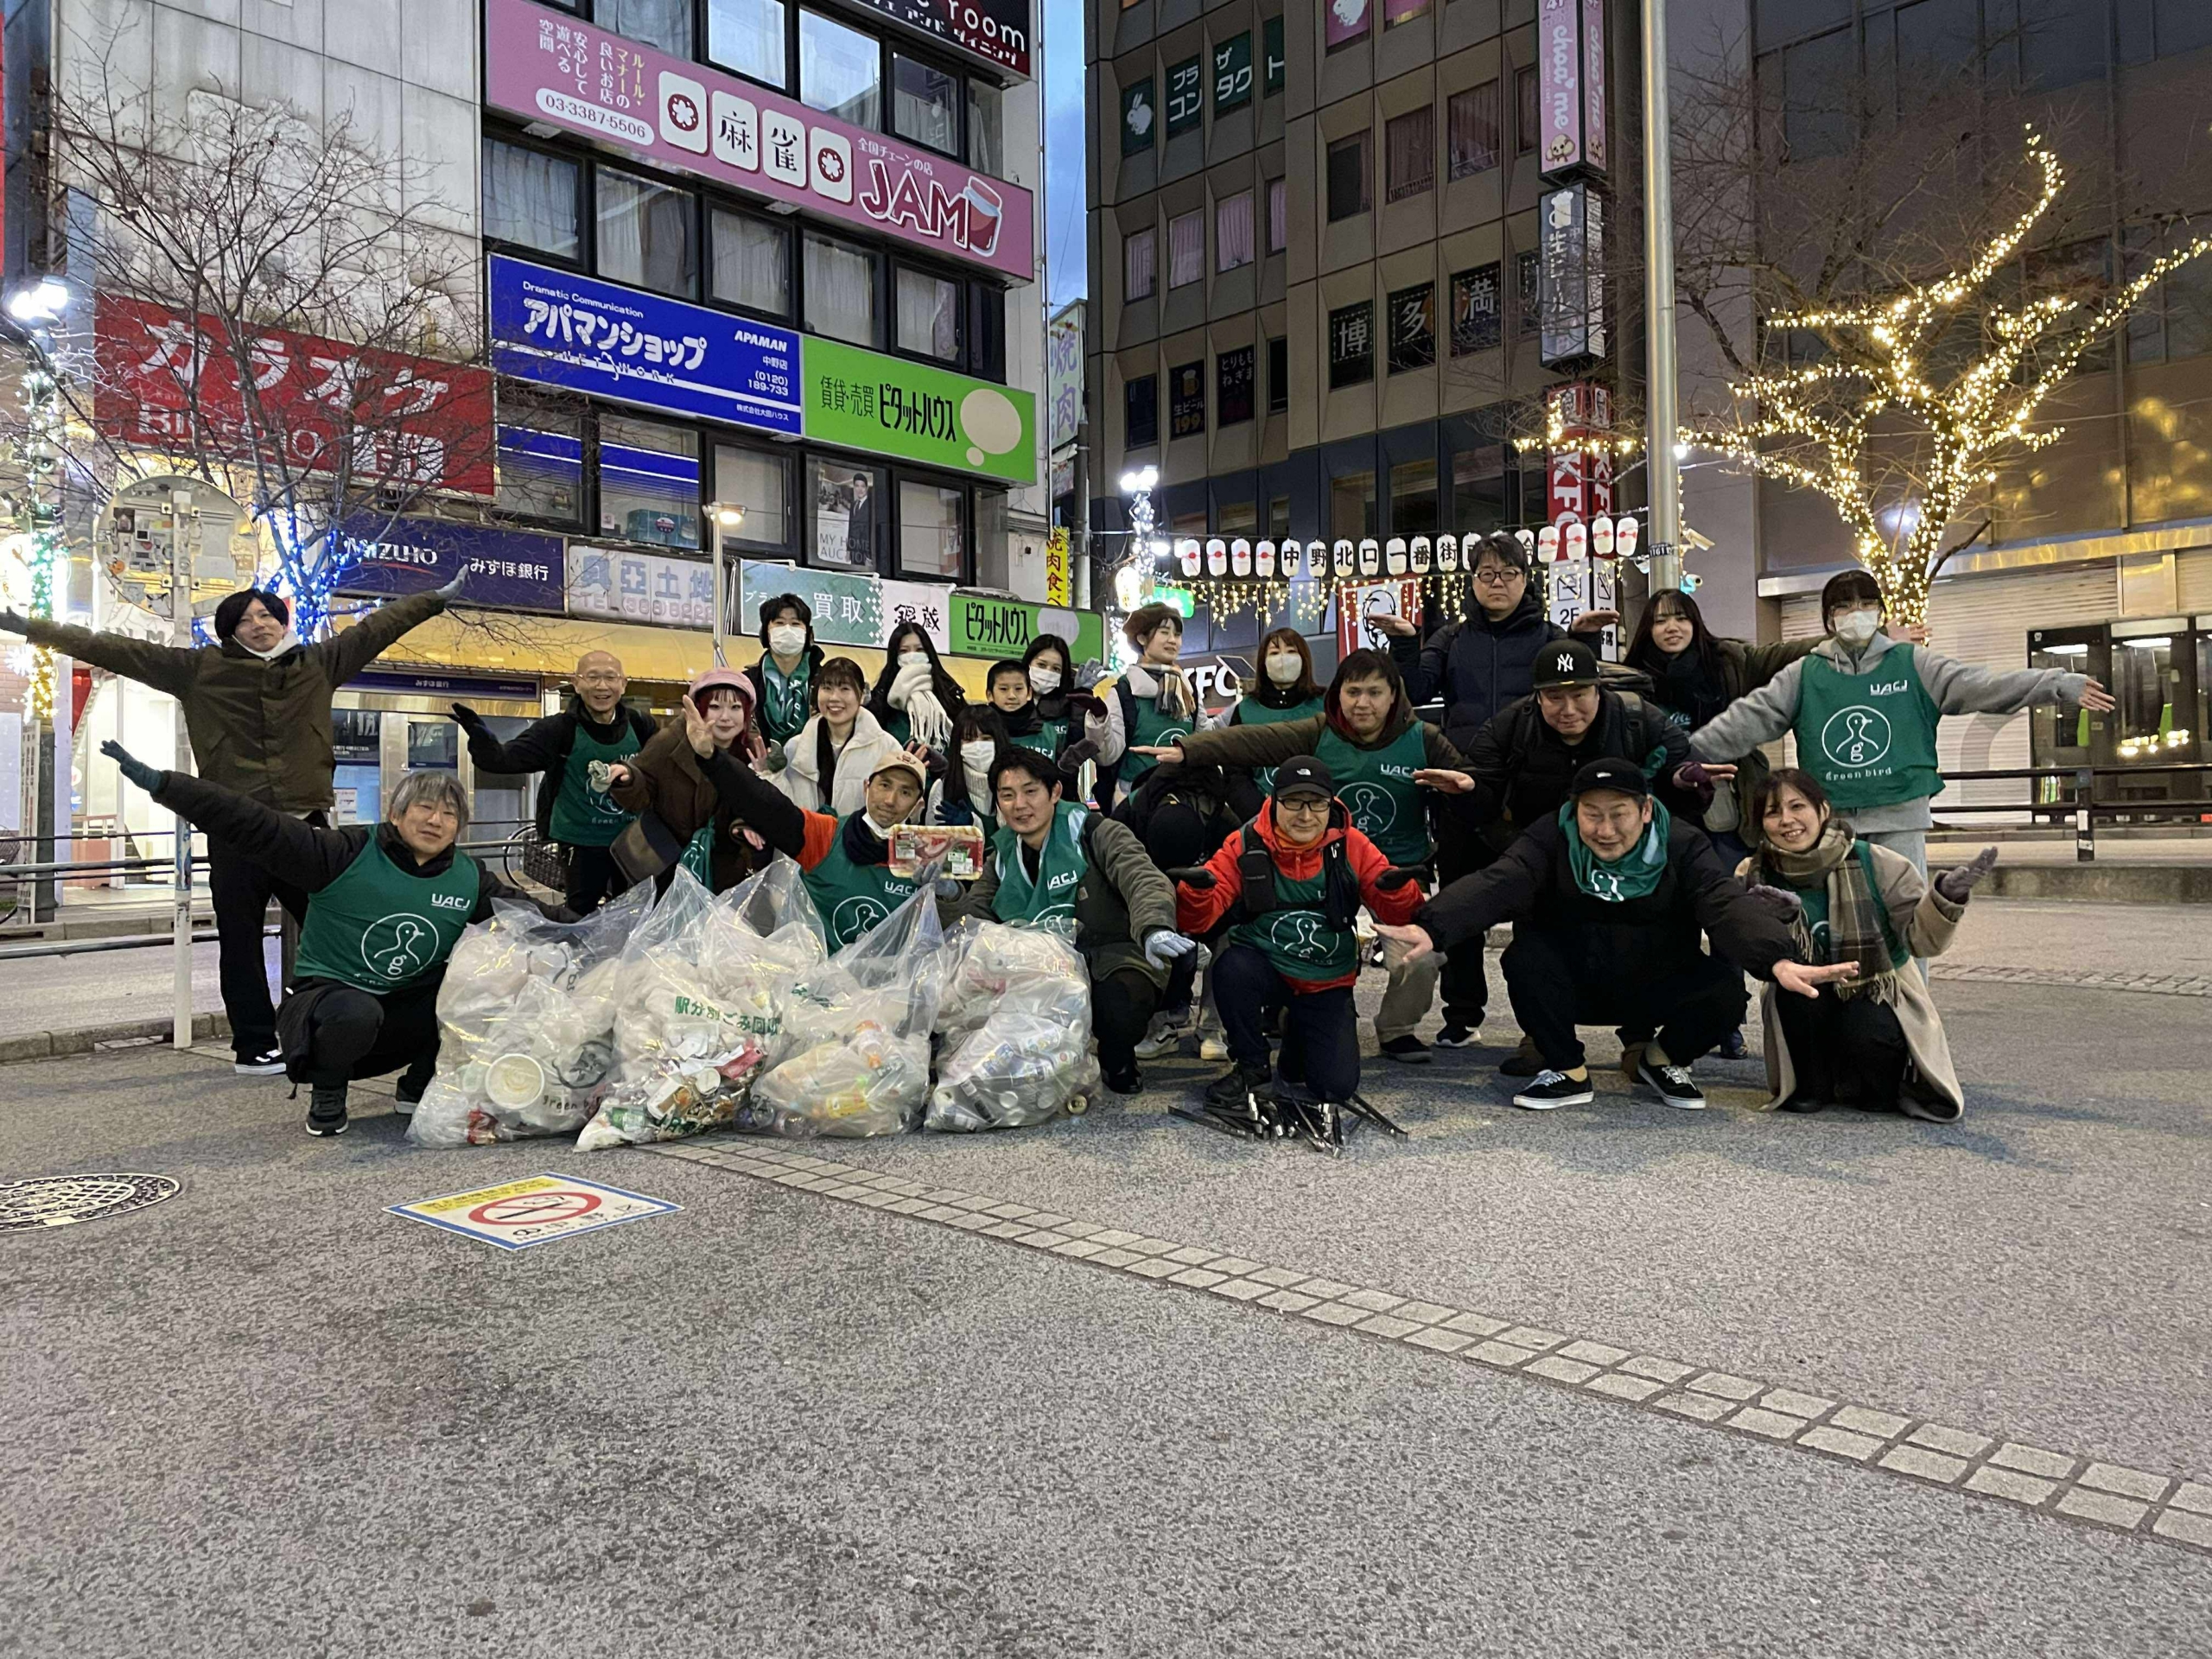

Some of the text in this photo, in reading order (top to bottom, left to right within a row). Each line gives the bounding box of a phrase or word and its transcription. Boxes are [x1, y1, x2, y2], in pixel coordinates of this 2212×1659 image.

[539, 19, 554, 53] 空間
[949, 1, 1025, 52] room
[556, 23, 571, 74] 遊べる
[573, 30, 588, 95] 安心して
[600, 41, 613, 105] 良いお店
[615, 47, 630, 109] マナーの
[1169, 55, 1284, 122] コンタクト
[545, 94, 645, 139] 03-3387-5506
[858, 137, 934, 176] 全国チェーンの店
[859, 159, 970, 249] JAM
[523, 280, 644, 320] Dramatic Communication
[523, 297, 708, 371] アパマンショップ
[734, 329, 788, 353] APAMAN
[139, 319, 449, 417] カラオケ
[754, 371, 790, 388] (0120)
[762, 355, 788, 372] 中野店
[747, 378, 790, 397] 189-733
[820, 375, 875, 420] 賃貸・売買
[879, 383, 957, 442] ピタットハウス
[1594, 451, 1611, 518] KF
[819, 532, 869, 552] MY HOME
[470, 557, 549, 582] みずほ銀行
[813, 593, 864, 624] 買取
[965, 602, 1030, 647] ピタットハウス
[1557, 653, 1573, 672] NY
[1870, 679, 1908, 696] UACJ
[1380, 763, 1414, 776] UAC
[1825, 766, 1892, 781] green bird
[431, 893, 471, 911] UACJ
